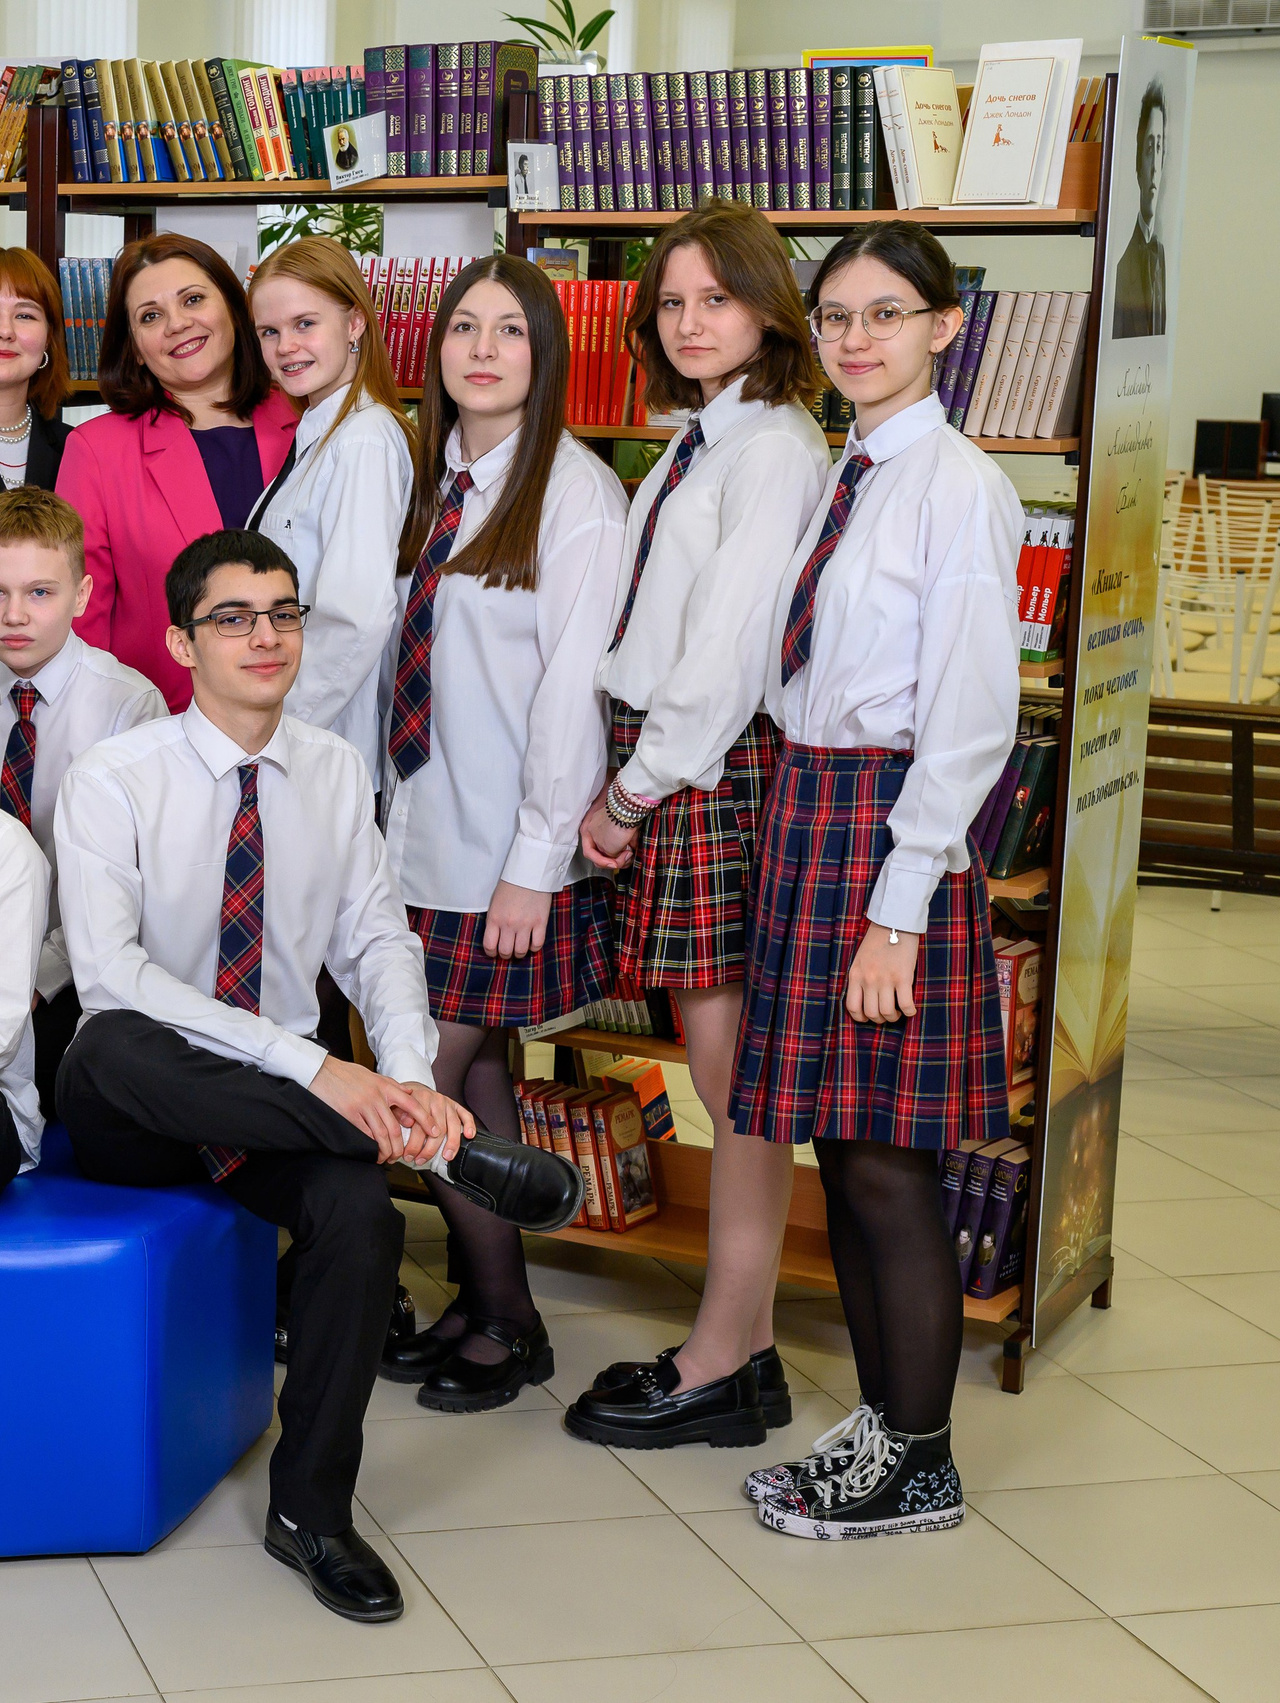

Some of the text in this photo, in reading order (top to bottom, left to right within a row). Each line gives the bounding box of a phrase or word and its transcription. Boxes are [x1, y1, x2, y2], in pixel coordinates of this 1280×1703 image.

[240, 78, 257, 111] ГОЛДИНГ
[257, 77, 273, 110] ГОЛДИНГ
[915, 101, 952, 111] Дочь снегов
[985, 94, 1037, 104] Дочь снегов
[564, 142, 572, 173] ЛОНДОН
[583, 142, 591, 173] ЛОНДОН
[601, 141, 609, 173] ЛОНДОН
[621, 140, 630, 172] ЛОНДОН
[640, 140, 648, 171] ЛОНДОН
[662, 140, 671, 172] ЛОНДОН
[680, 139, 689, 172] ЛОНДОН
[1091, 569, 1122, 597] «Книга
[1025, 585, 1040, 620] Мольер
[1038, 587, 1052, 622] Мольер
[1087, 616, 1145, 651] великая вещь,
[1083, 669, 1138, 706] пока человек
[1080, 726, 1121, 764] умеет ею
[1076, 769, 1139, 814] пользоваться».
[582, 1164, 595, 1205] РЕМАРК
[606, 1182, 615, 1214] РЕМАРК
[763, 1509, 786, 1530] Me
[844, 1526, 867, 1534] STRAY
